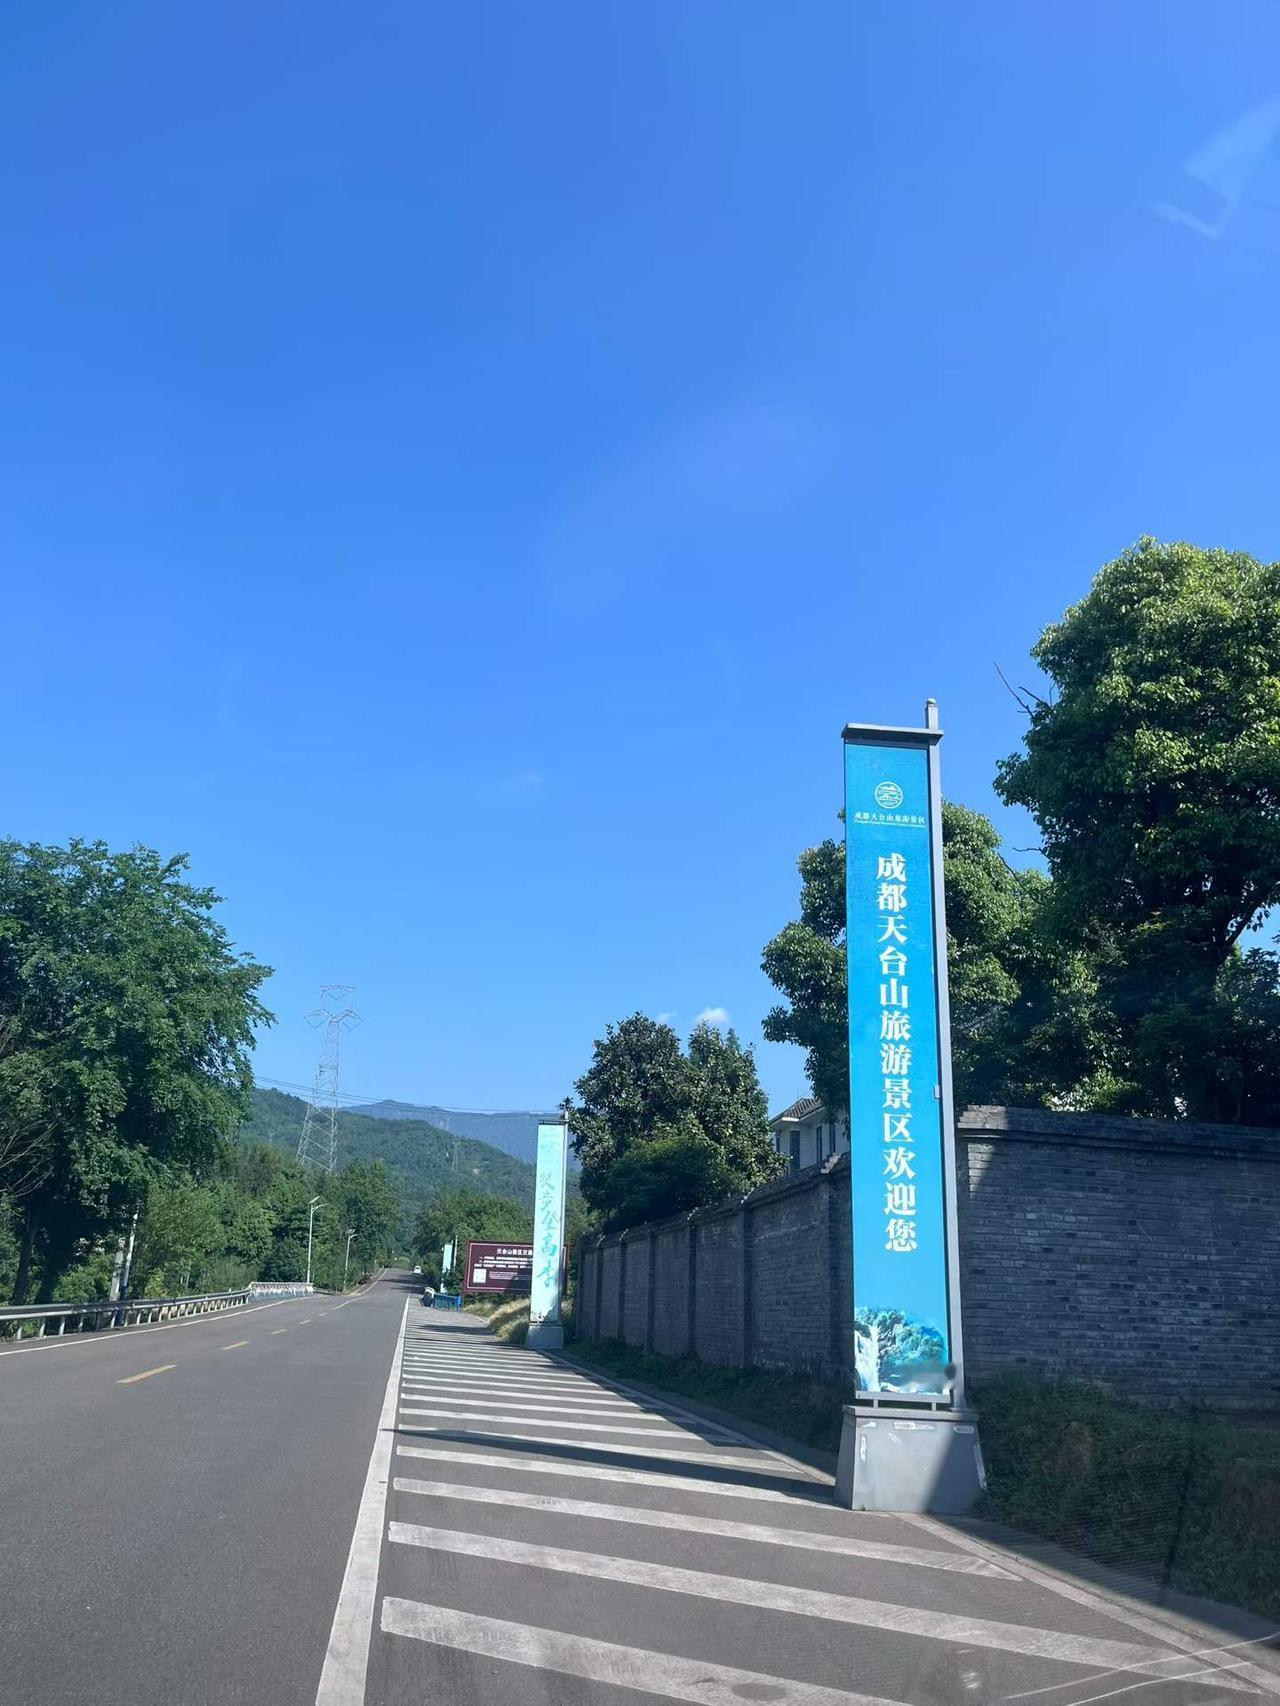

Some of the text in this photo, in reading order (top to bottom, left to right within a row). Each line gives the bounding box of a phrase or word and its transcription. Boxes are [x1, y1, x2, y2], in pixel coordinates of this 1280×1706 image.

[876, 852, 918, 1252] 成都天台山旅游景区欢迎您
